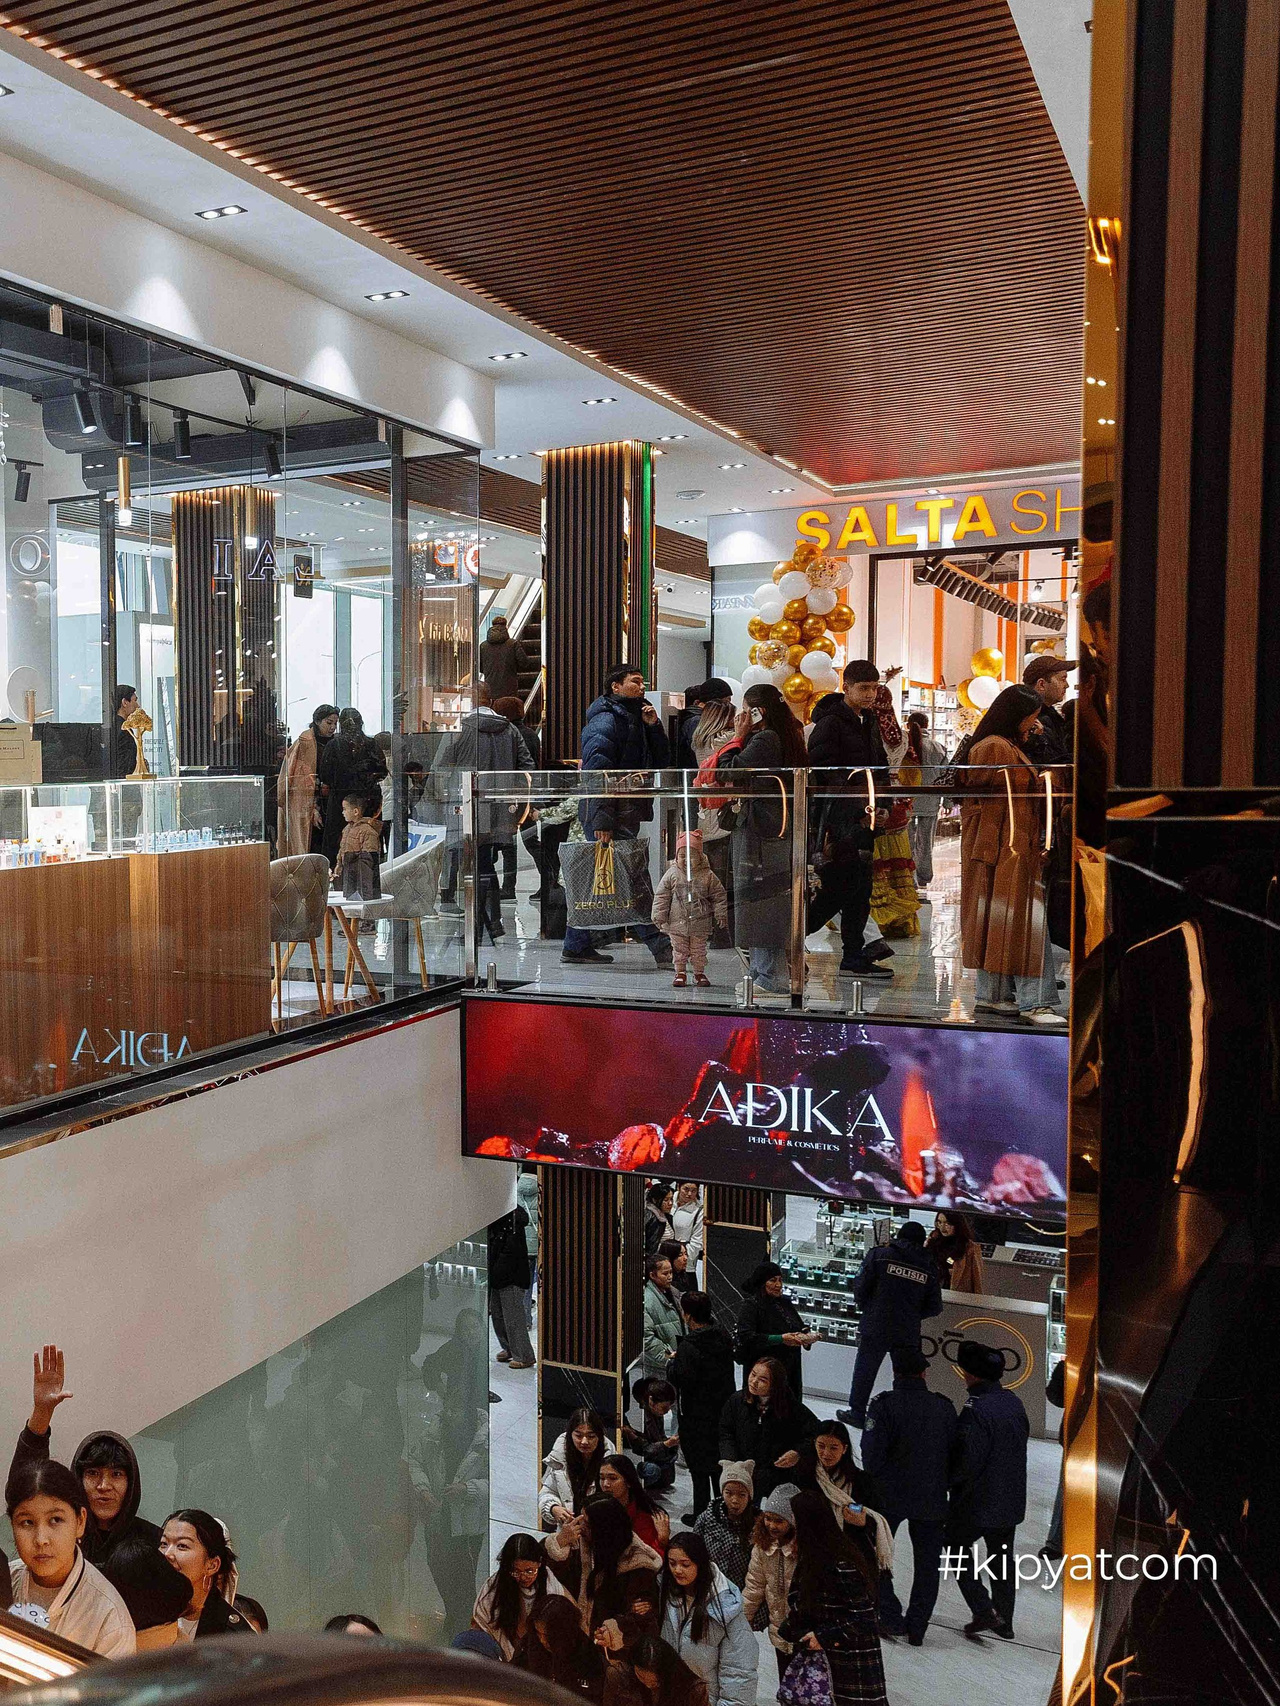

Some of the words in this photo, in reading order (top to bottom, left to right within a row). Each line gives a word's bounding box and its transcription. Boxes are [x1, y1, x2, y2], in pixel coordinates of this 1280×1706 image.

[795, 495, 998, 551] SALTA
[574, 901, 604, 910] ZERO
[698, 1081, 895, 1141] ADIKA
[748, 1135, 786, 1147] PERFUME
[787, 1139, 793, 1147] &
[794, 1140, 840, 1151] COSMETICS
[888, 1264, 926, 1283] POLISIA
